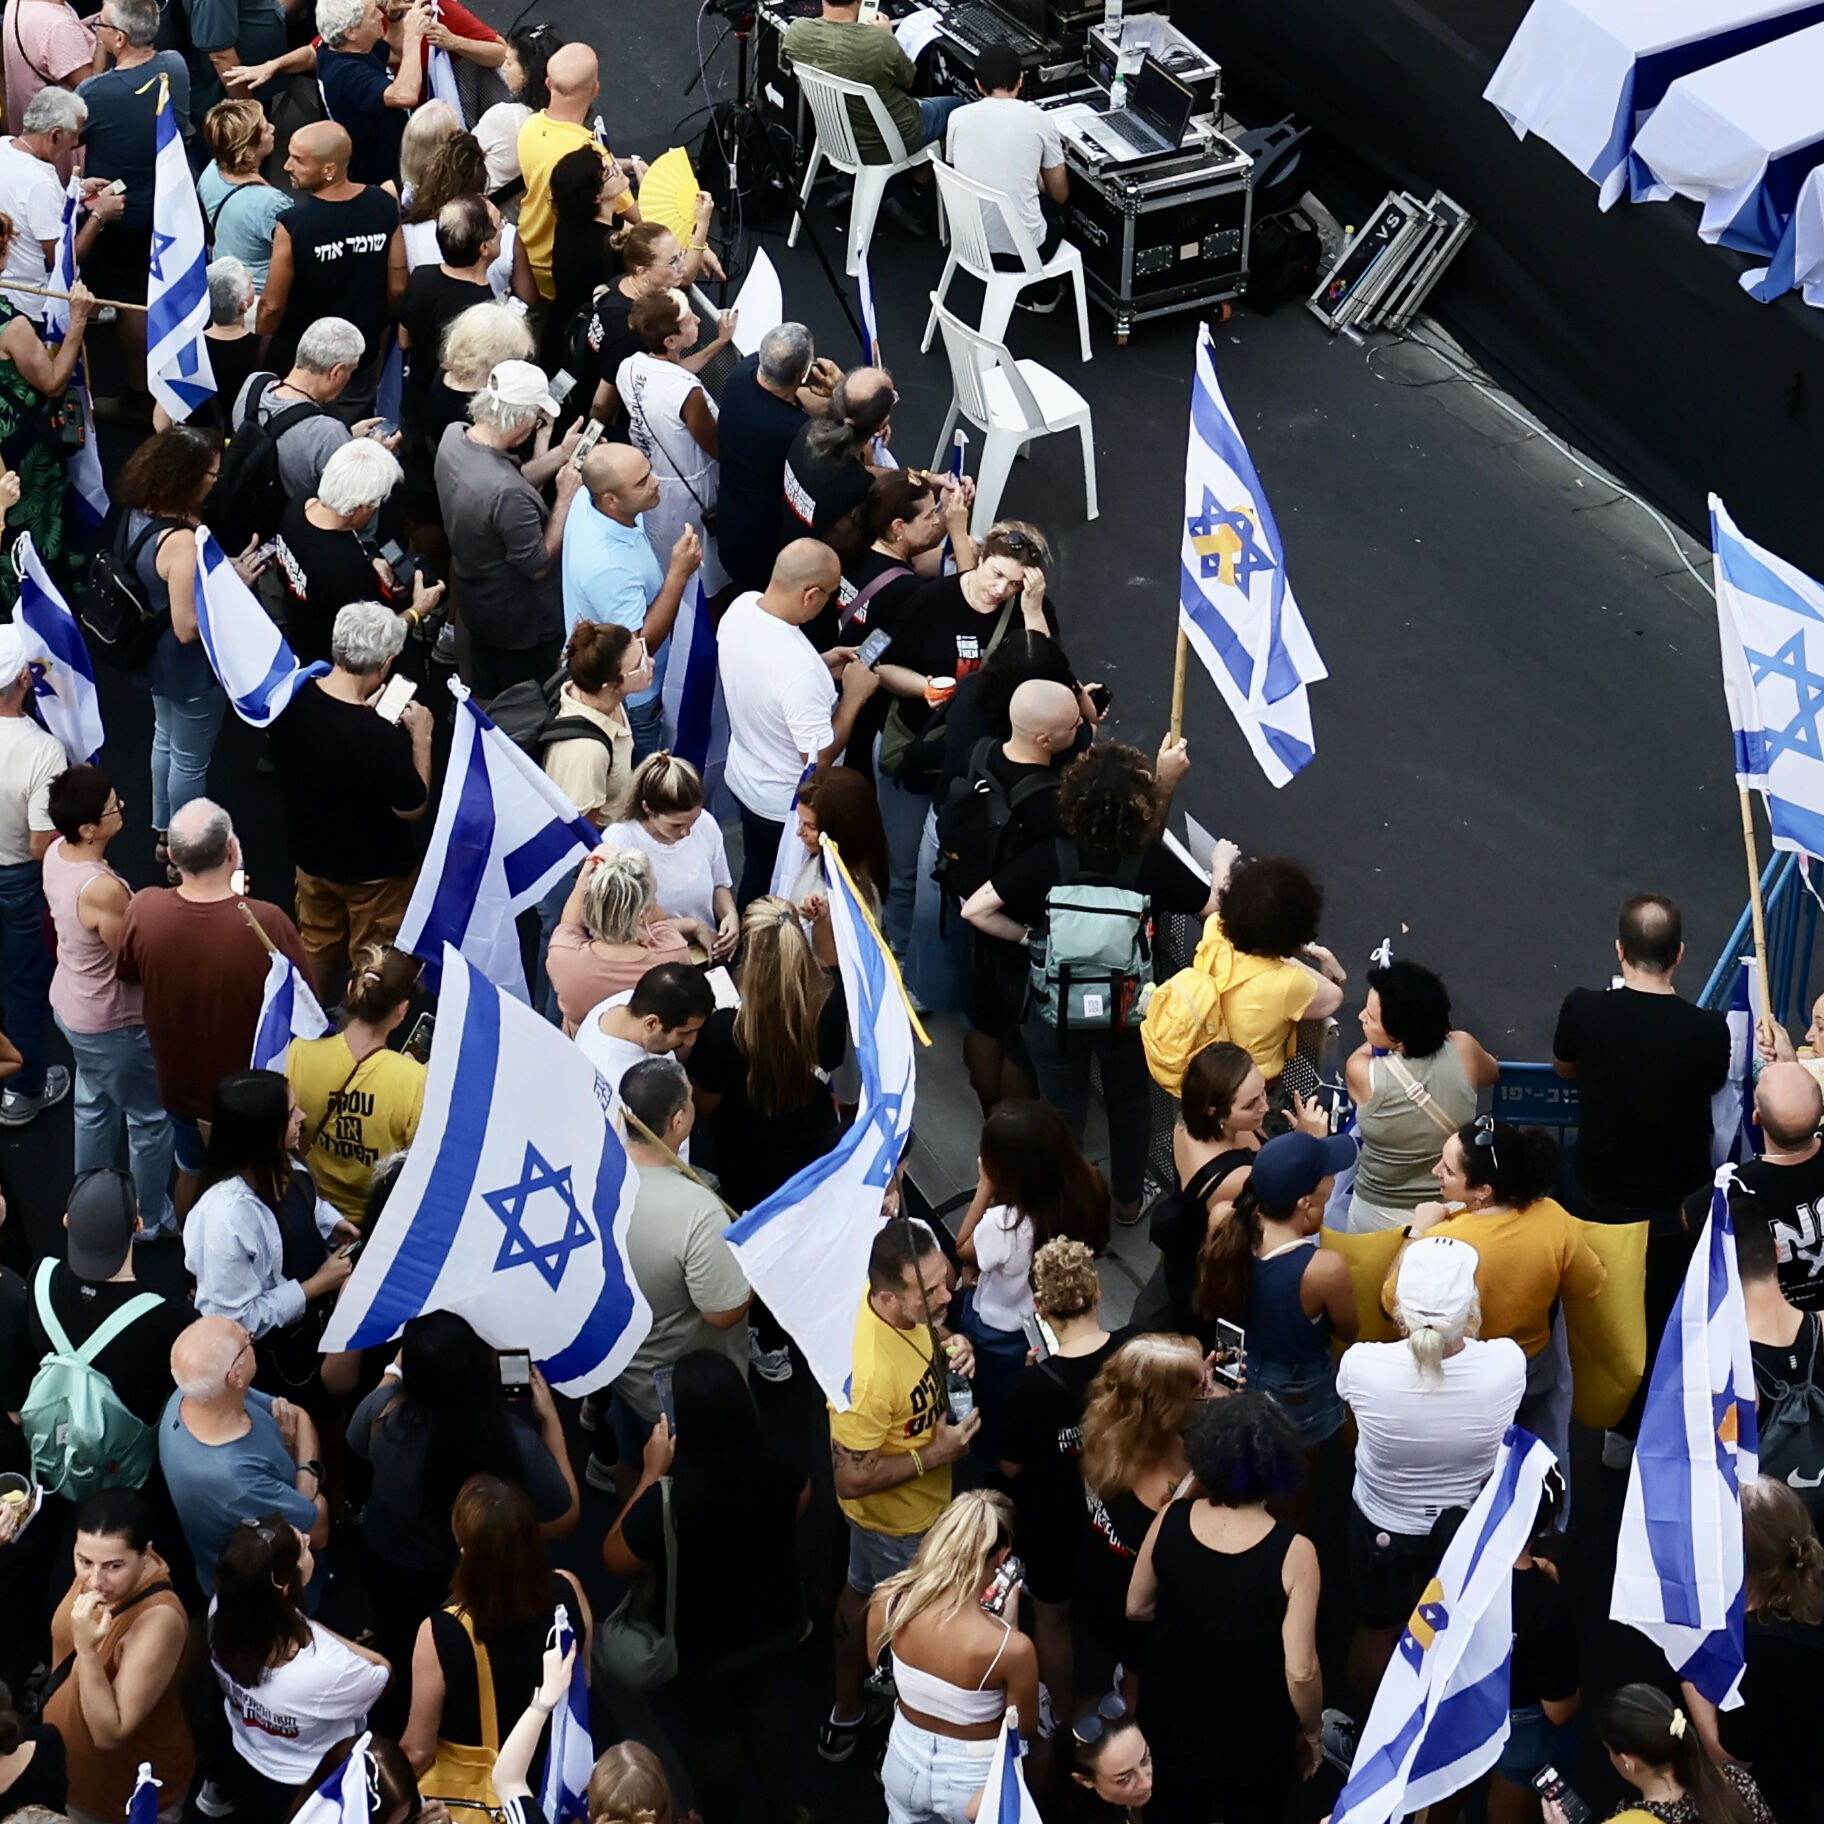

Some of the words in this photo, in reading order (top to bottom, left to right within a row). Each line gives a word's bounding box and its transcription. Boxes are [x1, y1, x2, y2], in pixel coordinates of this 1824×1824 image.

[1375, 213, 1400, 240] VS
[314, 240, 344, 263] אחי
[345, 232, 387, 253] שומר
